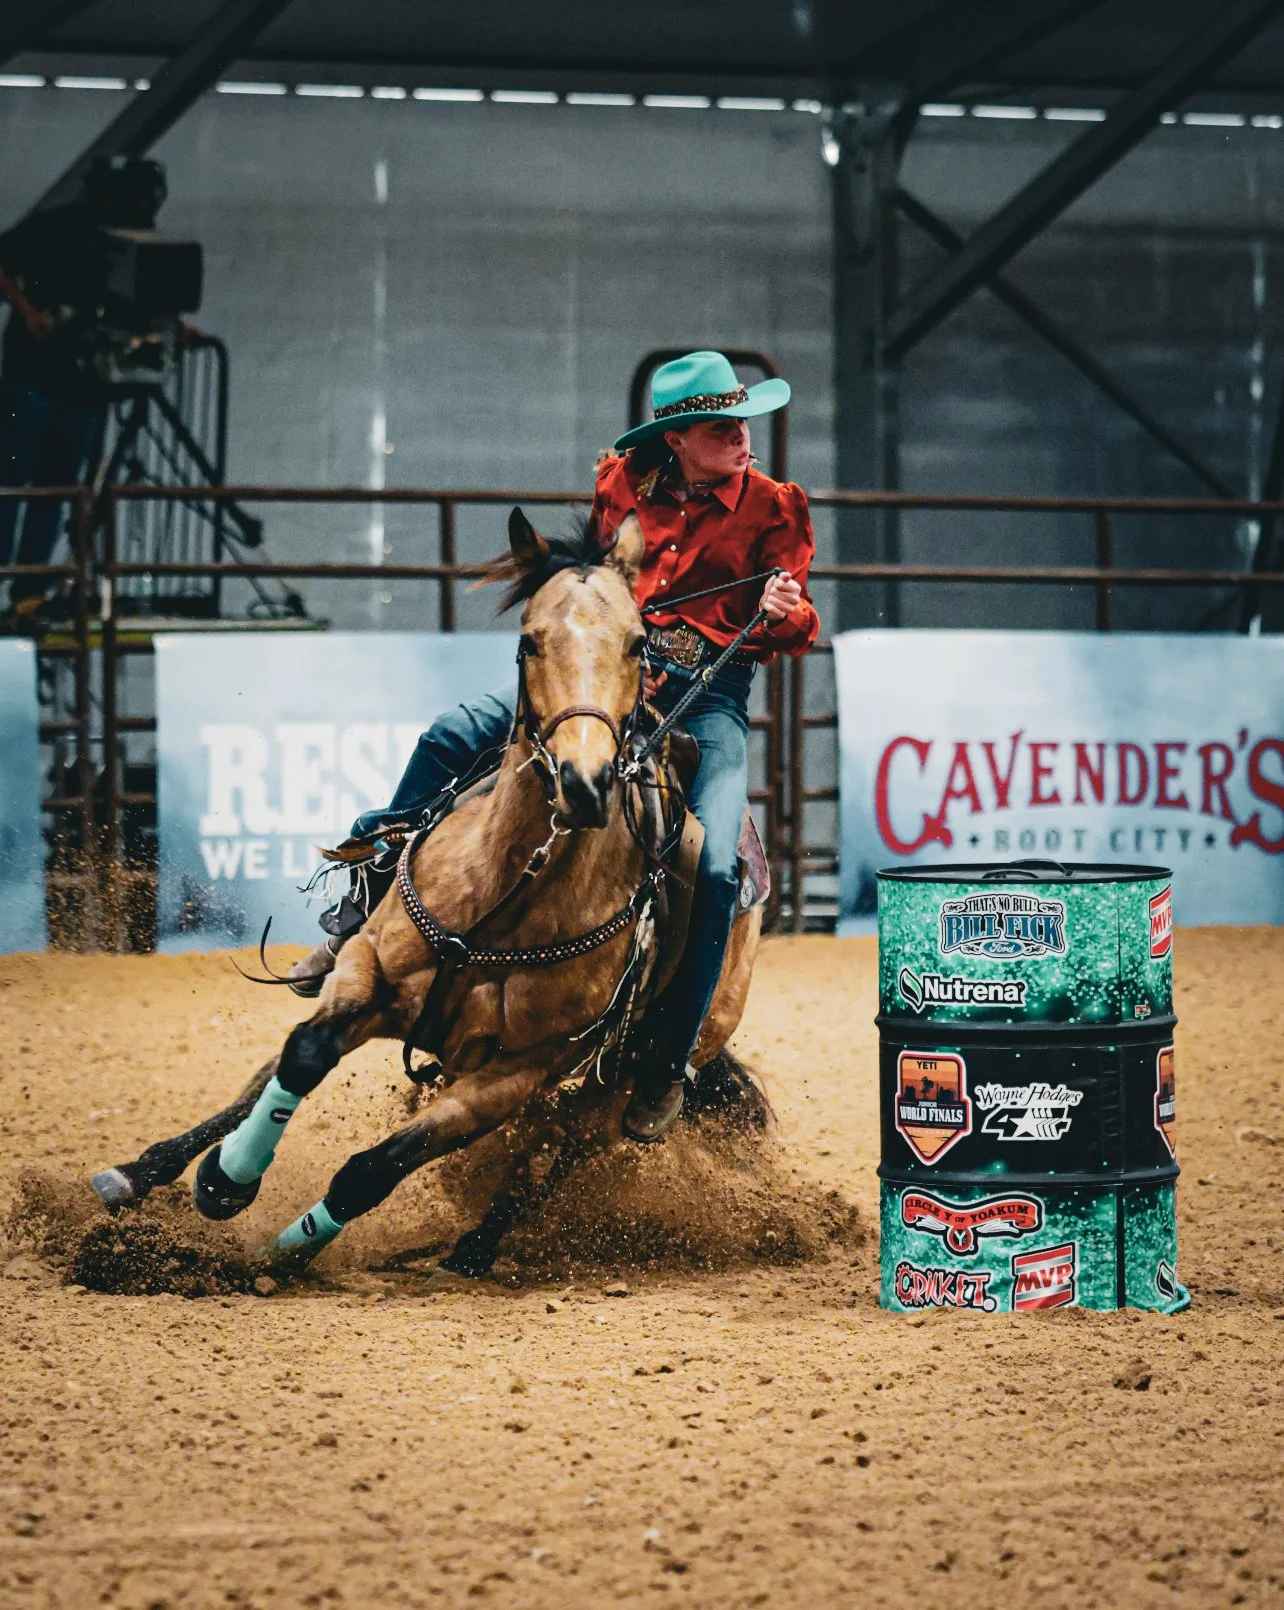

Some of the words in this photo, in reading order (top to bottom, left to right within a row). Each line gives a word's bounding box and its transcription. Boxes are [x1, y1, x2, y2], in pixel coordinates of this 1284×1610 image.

[874, 727, 1284, 856] CAVENDER'S
[1110, 827, 1191, 853] CITY
[200, 838, 270, 879] WE
[968, 897, 997, 912] THAT'S
[998, 896, 1011, 912] NO
[945, 915, 1001, 948] BILL
[1005, 915, 1061, 949] FICK
[989, 942, 1014, 953] Ford
[924, 978, 1019, 1001] Nutrena
[917, 1061, 937, 1070] YETI
[977, 1086, 1027, 1107] Wayne
[1020, 1085, 1081, 1105] Hodges
[900, 1106, 927, 1121] WORLD
[929, 1108, 963, 1123] FINALS
[905, 1199, 940, 1217] CIRCLE
[944, 1212, 953, 1221] Y
[970, 1205, 1029, 1223] YOAKUM
[954, 1230, 967, 1247] Y
[1016, 1263, 1073, 1294] MVP
